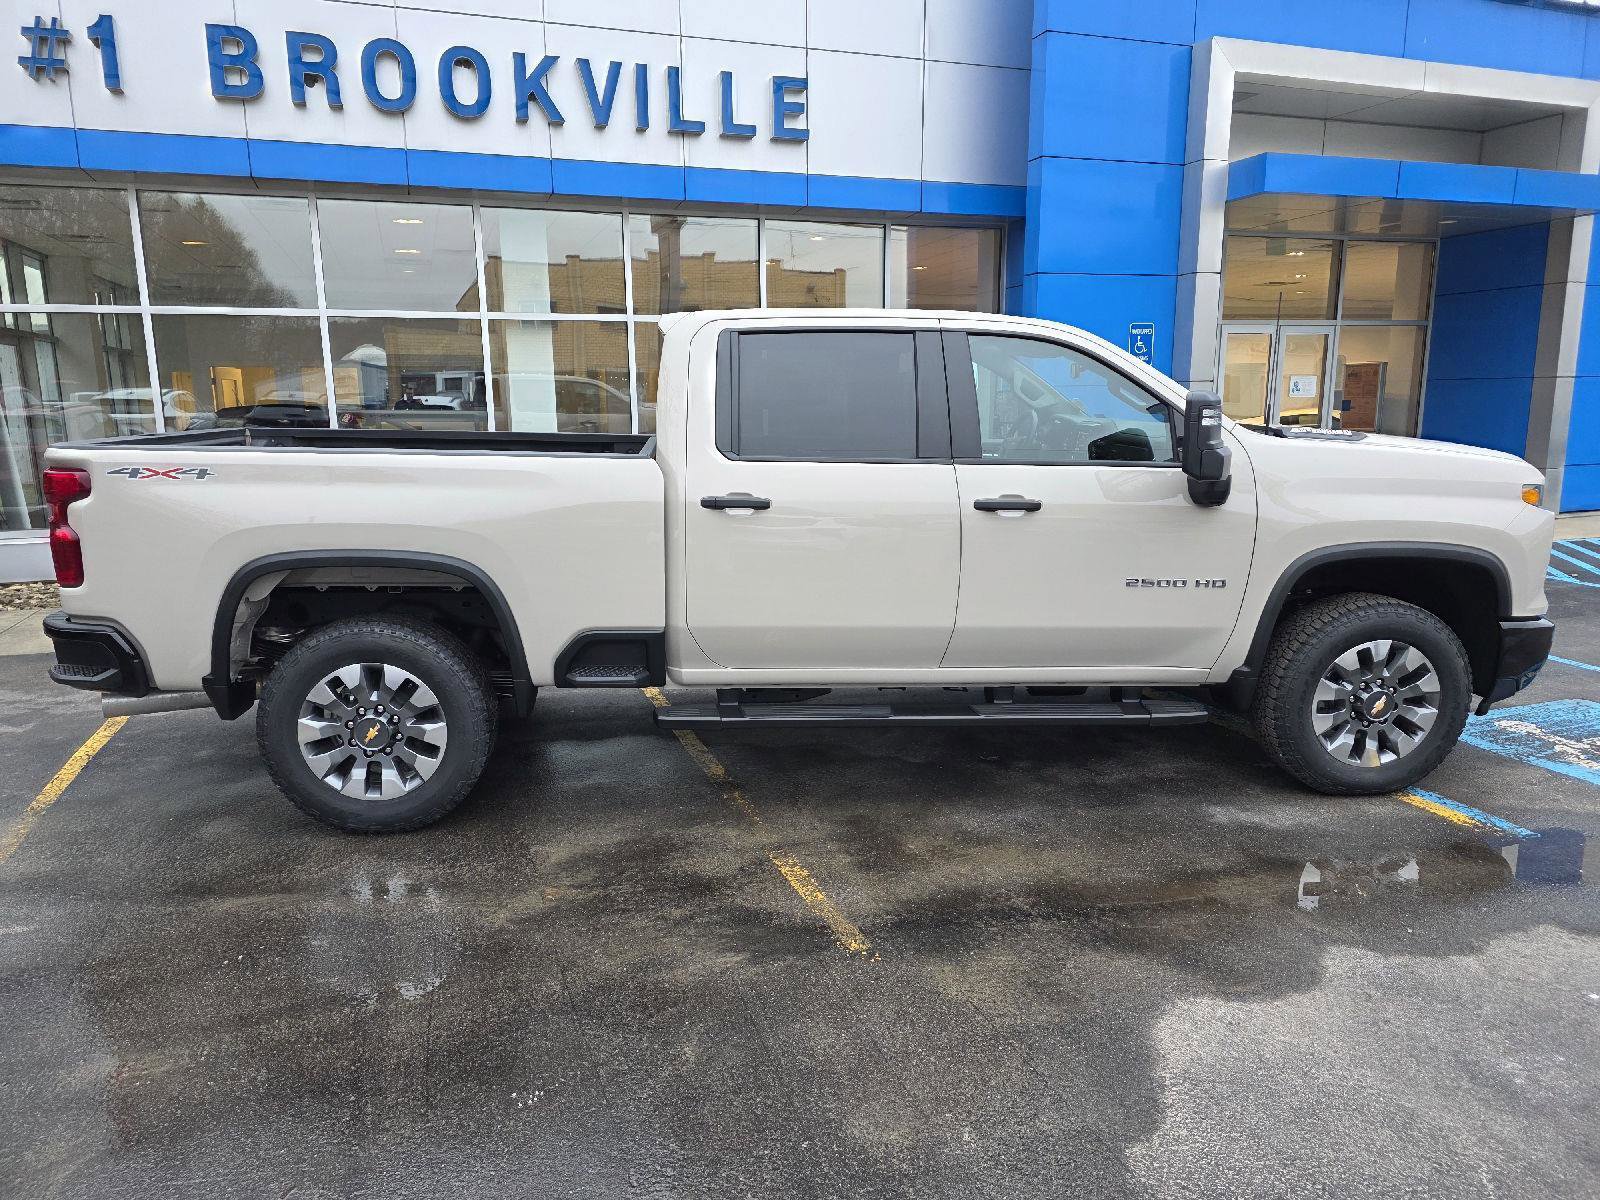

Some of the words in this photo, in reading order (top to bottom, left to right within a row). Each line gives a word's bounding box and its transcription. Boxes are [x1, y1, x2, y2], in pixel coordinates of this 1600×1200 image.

[18, 13, 124, 96] #1
[204, 22, 810, 144] BROOKVILLE
[1125, 577, 1188, 588] 2500
[1194, 578, 1227, 588] HD
